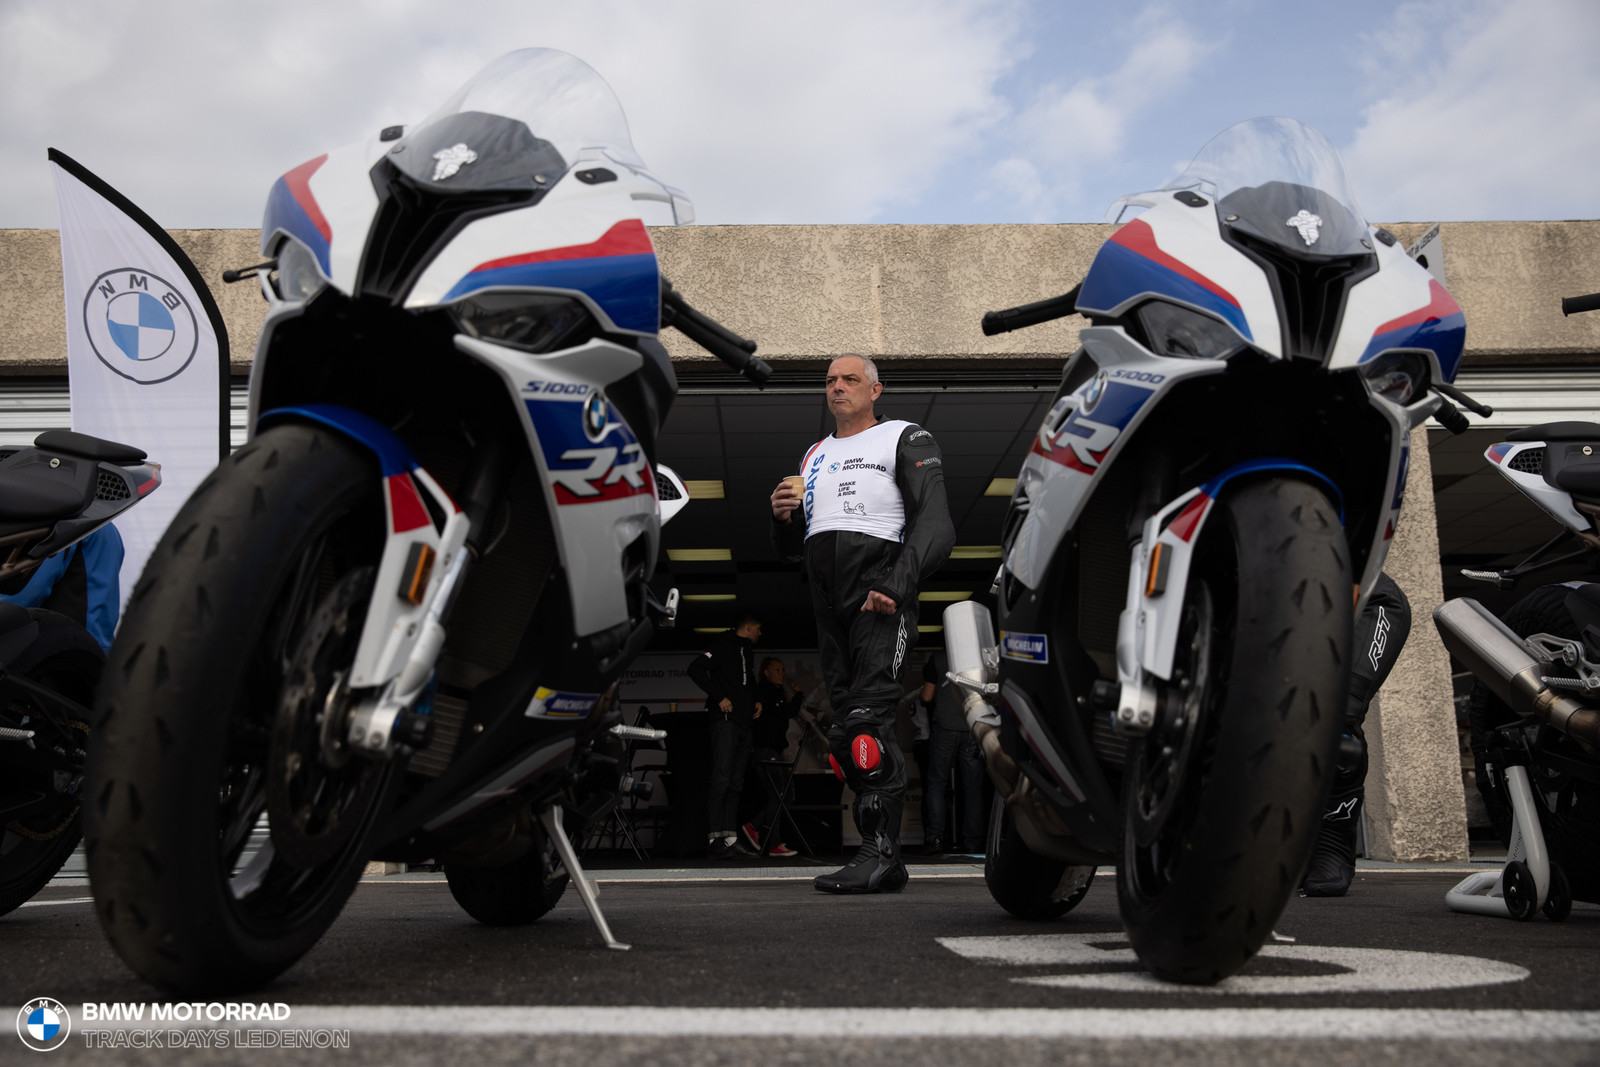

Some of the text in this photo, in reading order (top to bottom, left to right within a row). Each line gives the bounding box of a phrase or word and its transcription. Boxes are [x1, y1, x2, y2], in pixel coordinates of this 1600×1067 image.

[548, 442, 646, 496] RR
[841, 463, 887, 473] MOTORRAD
[892, 612, 908, 680] RST
[1368, 605, 1391, 672] RST
[668, 670, 687, 678] TRA
